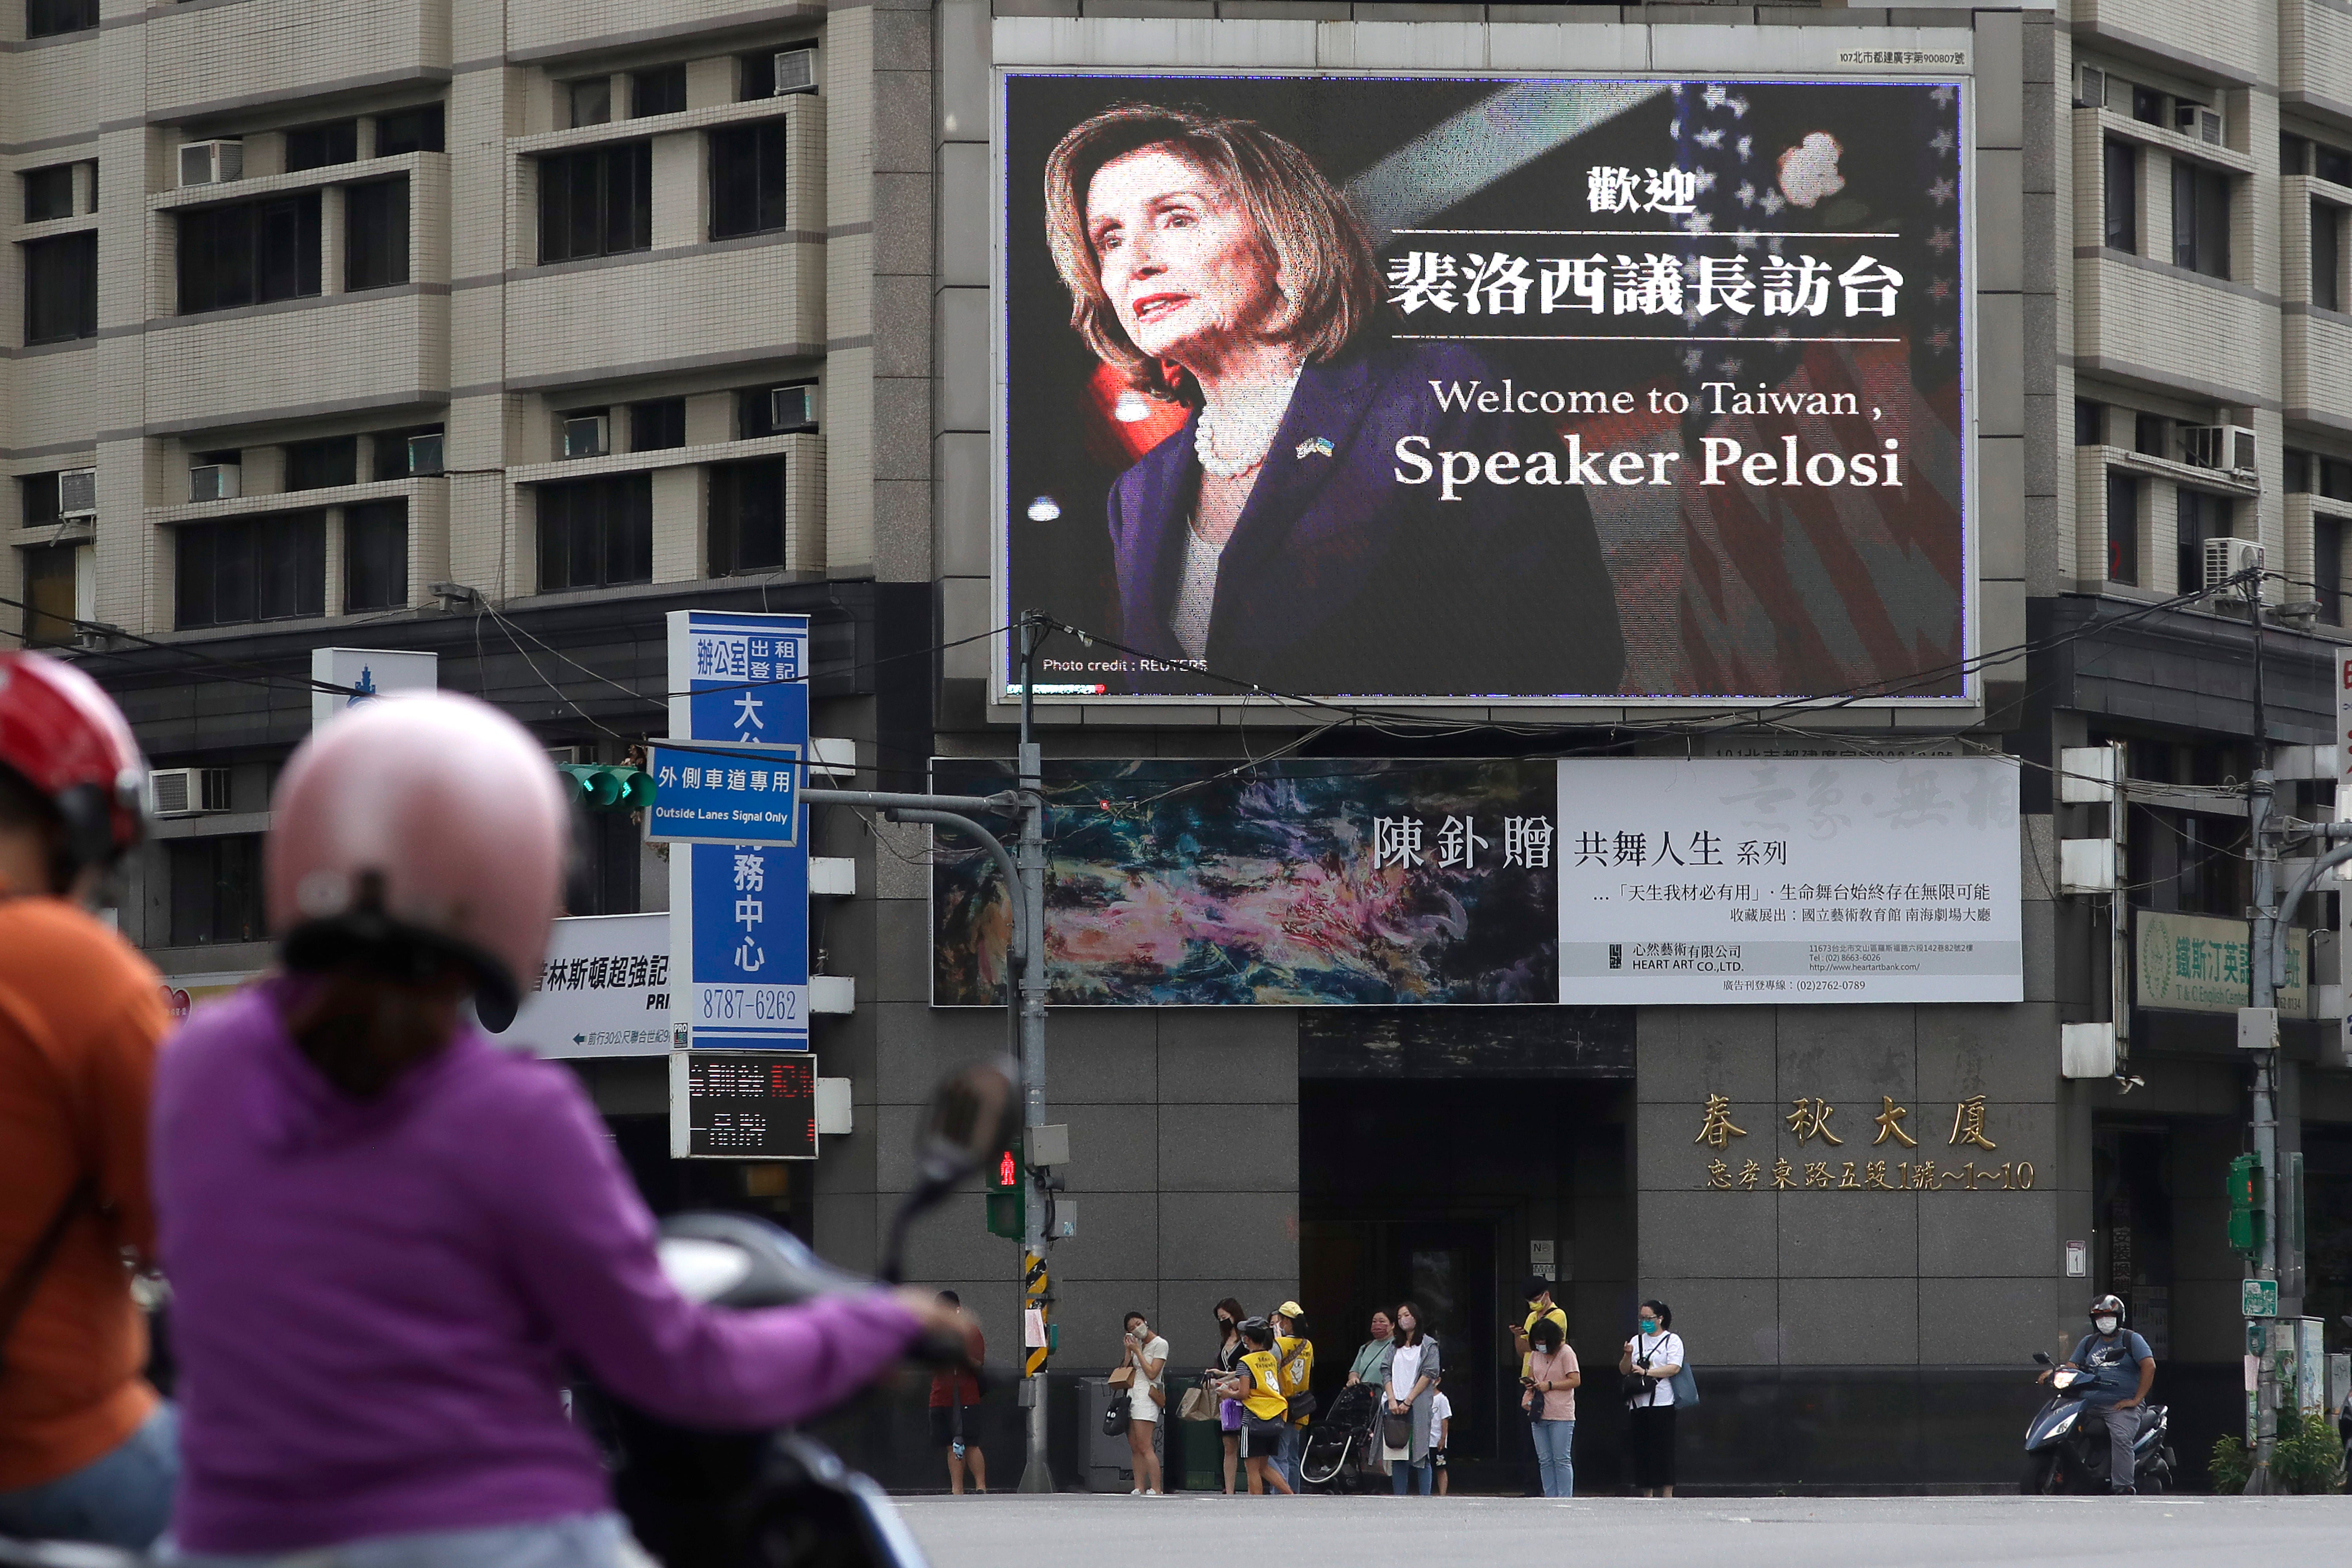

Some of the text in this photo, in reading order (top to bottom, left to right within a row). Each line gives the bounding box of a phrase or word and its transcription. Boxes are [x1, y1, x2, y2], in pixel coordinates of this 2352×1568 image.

[1587, 166, 1696, 214] 歡迎
[1387, 251, 1904, 318] 裴洛西議長訪台
[1429, 380, 1634, 415] Welcome
[1650, 385, 1689, 415] to
[1394, 435, 1901, 501] Speaker Pelosi
[697, 639, 746, 675] 辦公室
[751, 640, 795, 658] 出租
[751, 661, 795, 680] 登記
[1043, 659, 1083, 672] Photo
[1088, 659, 1127, 672] credit
[658, 766, 790, 793] 外側車道專用
[656, 807, 788, 825] Outside Lanes Signal Only
[1372, 814, 1555, 869] 陳釙贈
[1574, 830, 1787, 867] 共舞人生 系列
[1906, 908, 1991, 922] 南海劇場大廳
[1633, 943, 1740, 958] 心然藝術有限公司
[1633, 960, 1744, 973] HEART ART CO.,LTD.
[1809, 963, 1920, 972] http://www.heartartbank.com/
[646, 994, 670, 1010] PRI
[703, 989, 797, 1021] 8787-6262
[674, 1024, 687, 1033] PRO
[1695, 1093, 1998, 1151] 春秋大廈
